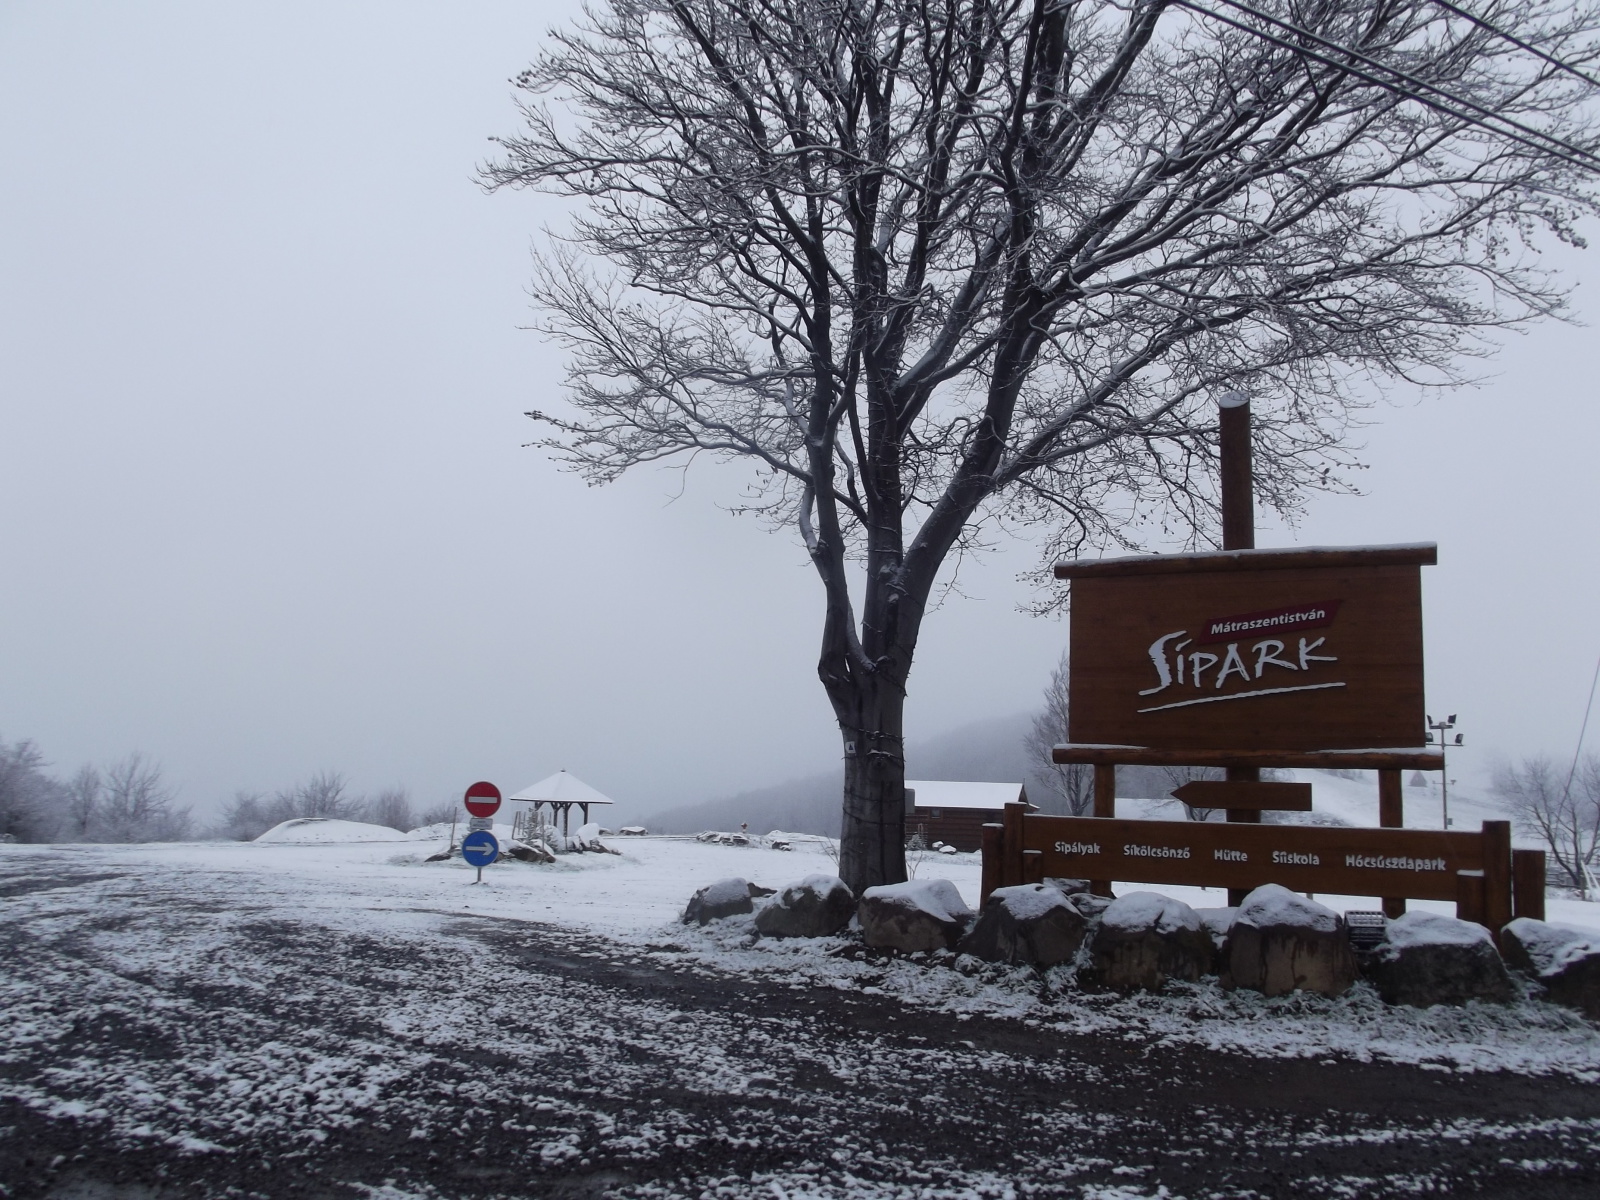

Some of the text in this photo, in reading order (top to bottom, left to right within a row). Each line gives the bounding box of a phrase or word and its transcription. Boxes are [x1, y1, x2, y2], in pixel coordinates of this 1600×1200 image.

[1211, 608, 1326, 635] Mátraszentistván
[1054, 841, 1446, 872] Sípályak Síkölcsönző Hütte Síiskola Hócsúszdapark
